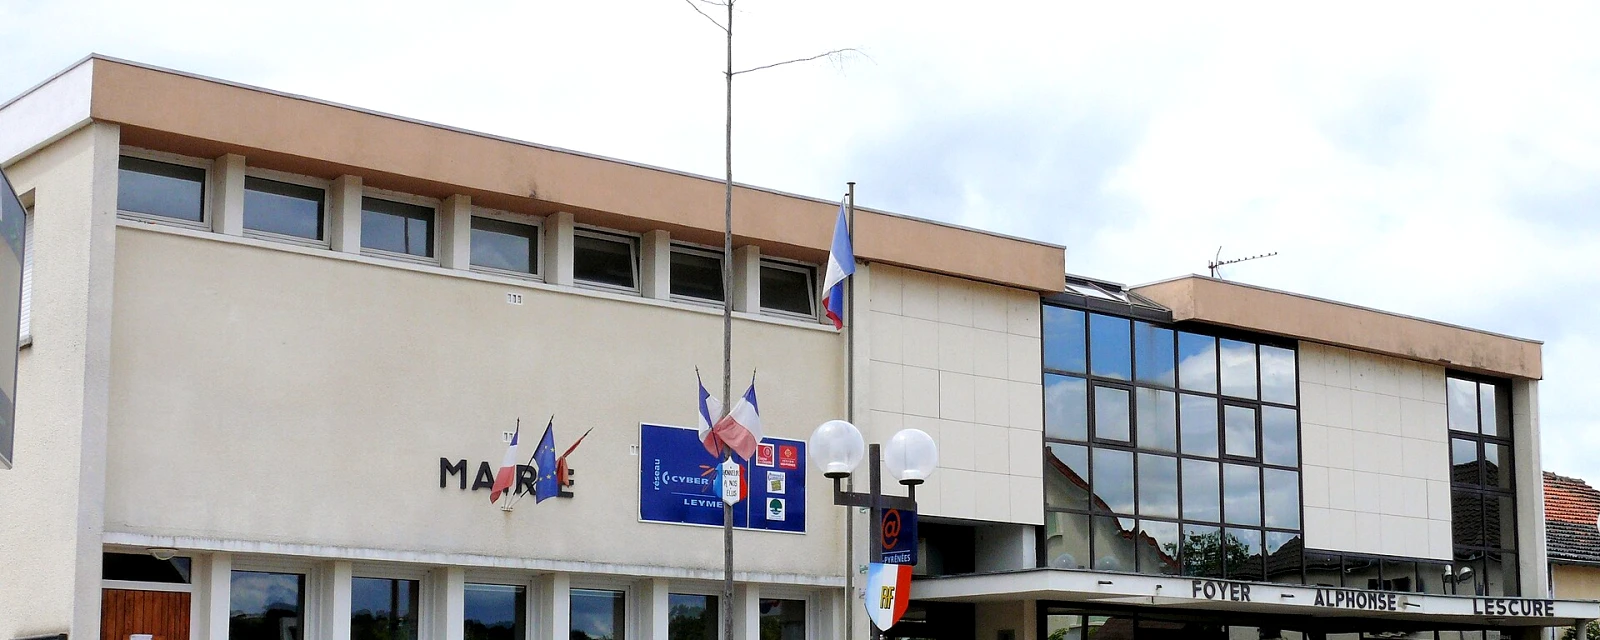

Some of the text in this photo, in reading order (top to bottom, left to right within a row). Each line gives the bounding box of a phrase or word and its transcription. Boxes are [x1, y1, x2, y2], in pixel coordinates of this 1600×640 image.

[440, 457, 574, 498] MARE
[671, 475, 709, 485] CYBER
[880, 586, 895, 609] RF
[1192, 580, 1555, 617] FOYER ALPHONSE LESCURE
